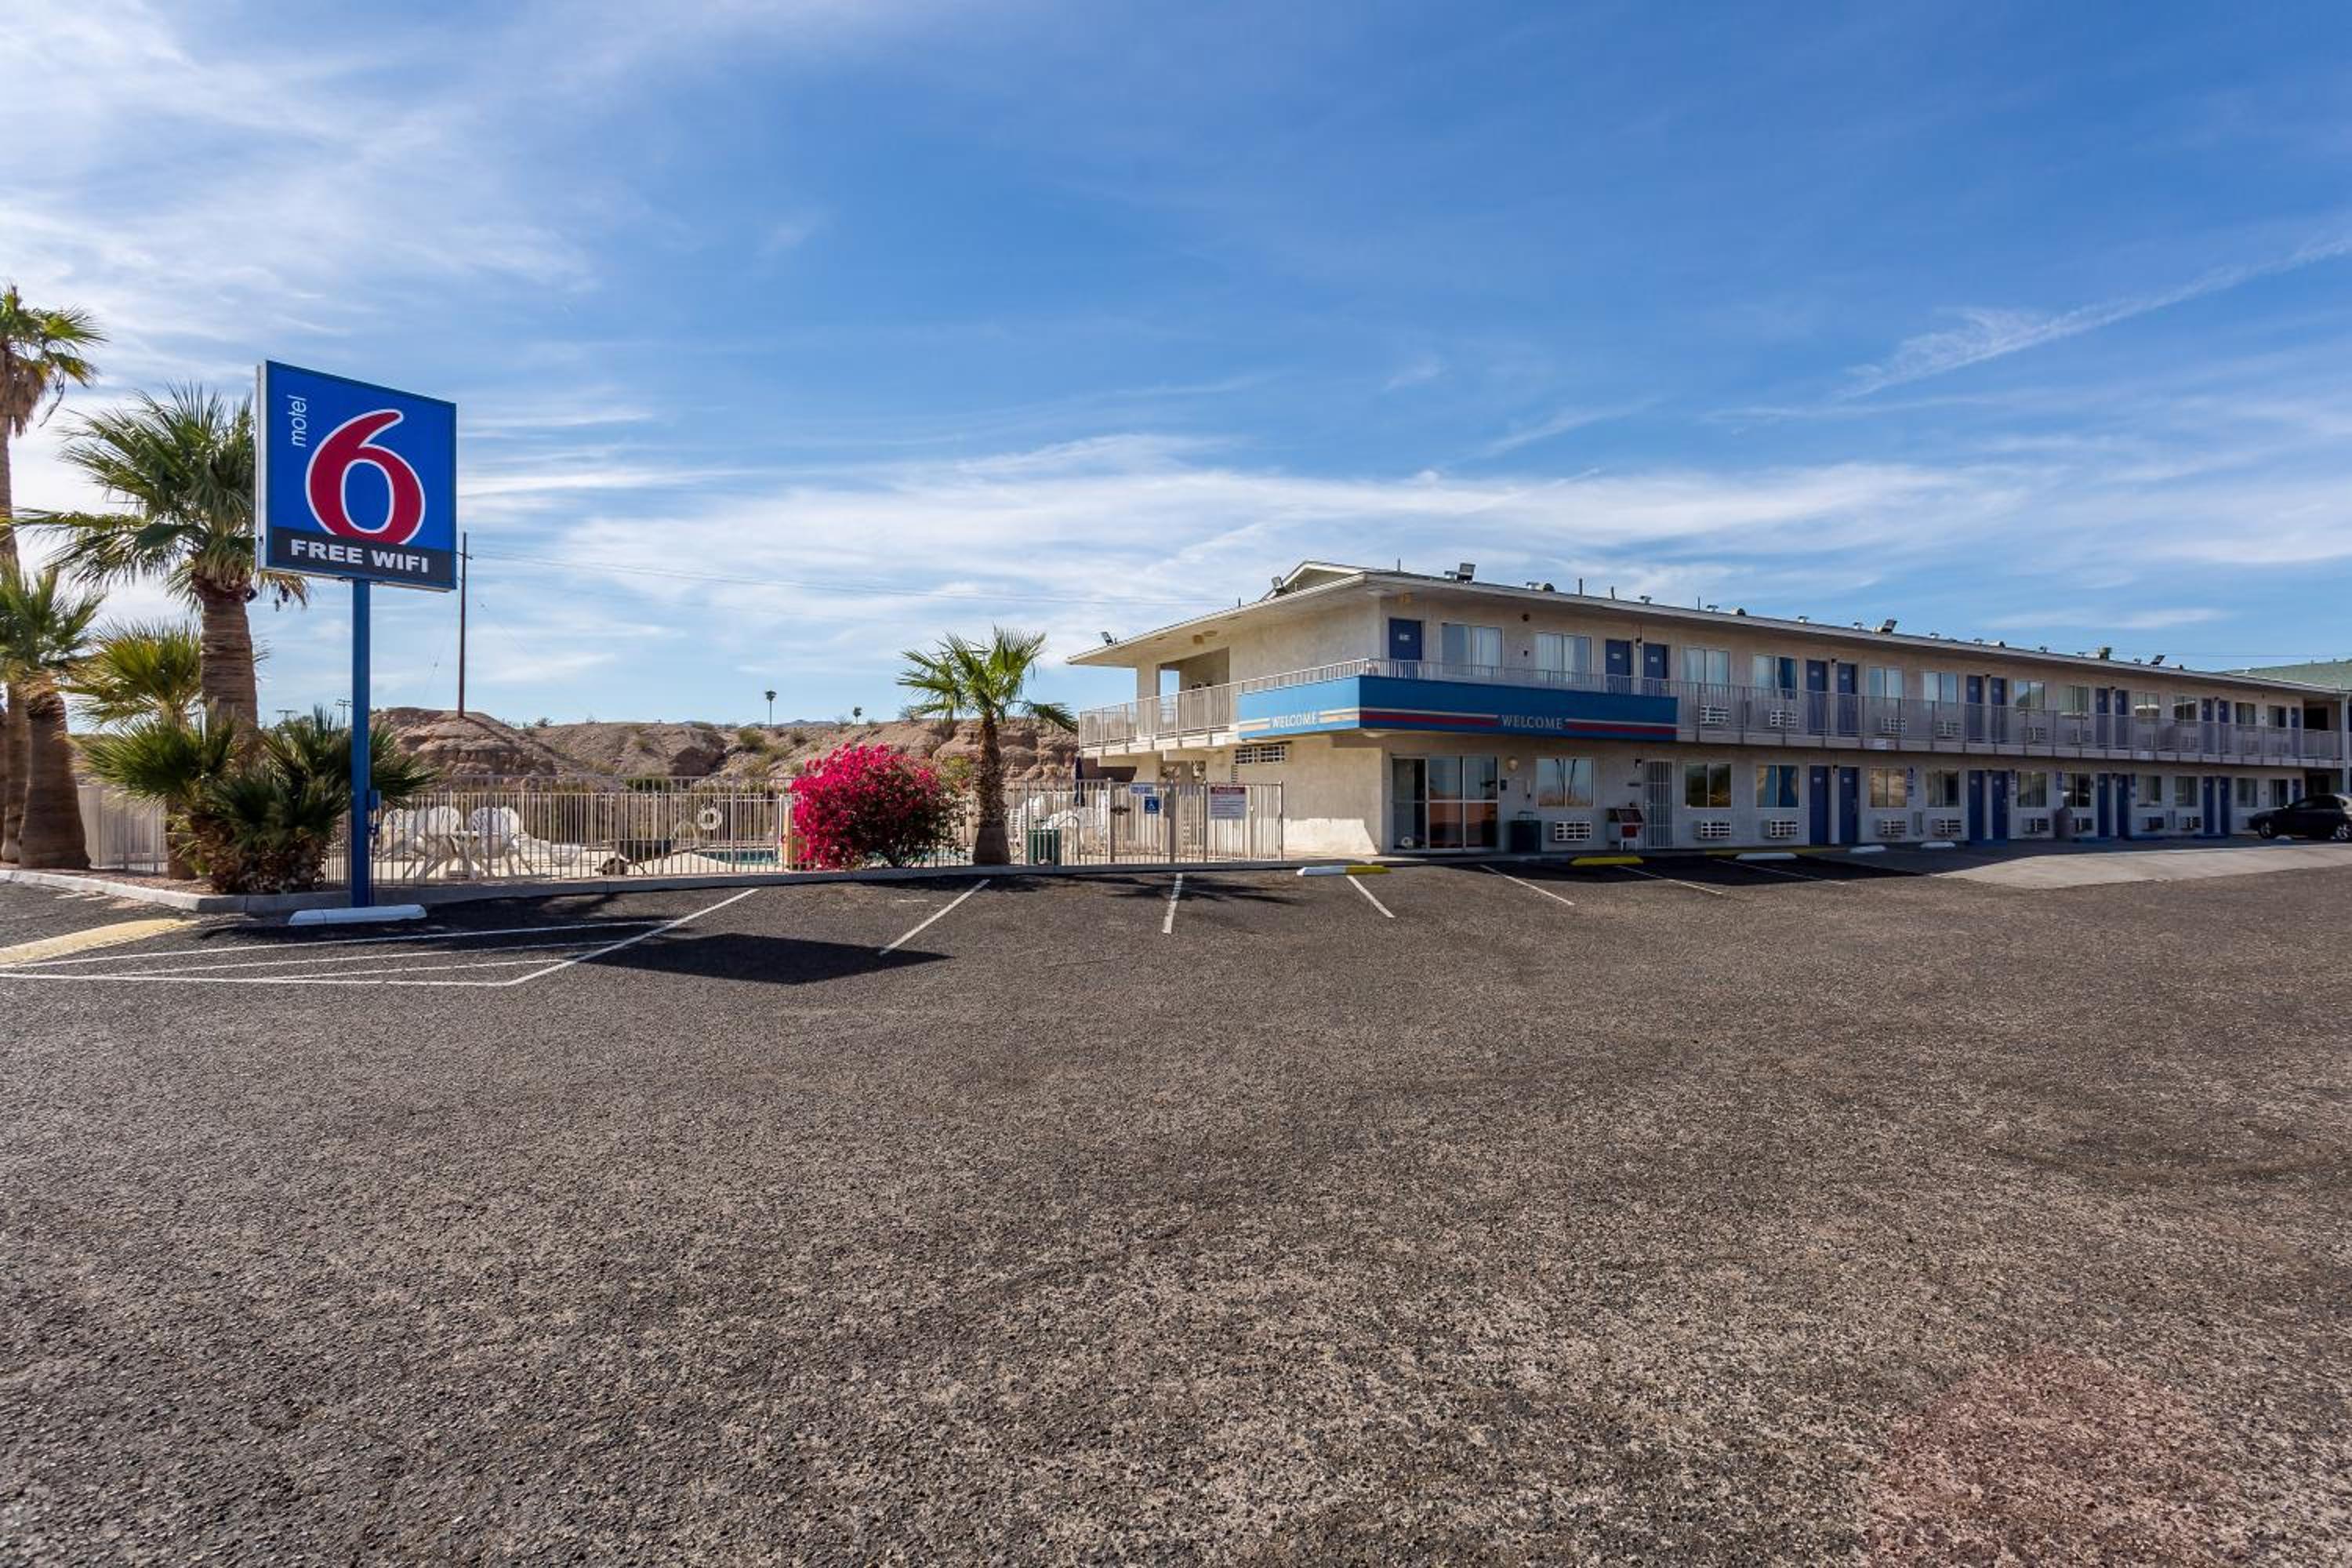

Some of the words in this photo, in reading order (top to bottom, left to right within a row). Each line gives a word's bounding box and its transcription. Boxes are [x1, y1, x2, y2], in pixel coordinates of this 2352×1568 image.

[287, 394, 307, 448] motel
[306, 408, 426, 545] 6
[291, 539, 364, 564] FREE
[371, 550, 429, 574] WIFI
[1271, 711, 1318, 728] WELCOME
[1501, 714, 1563, 730] WELCOME
